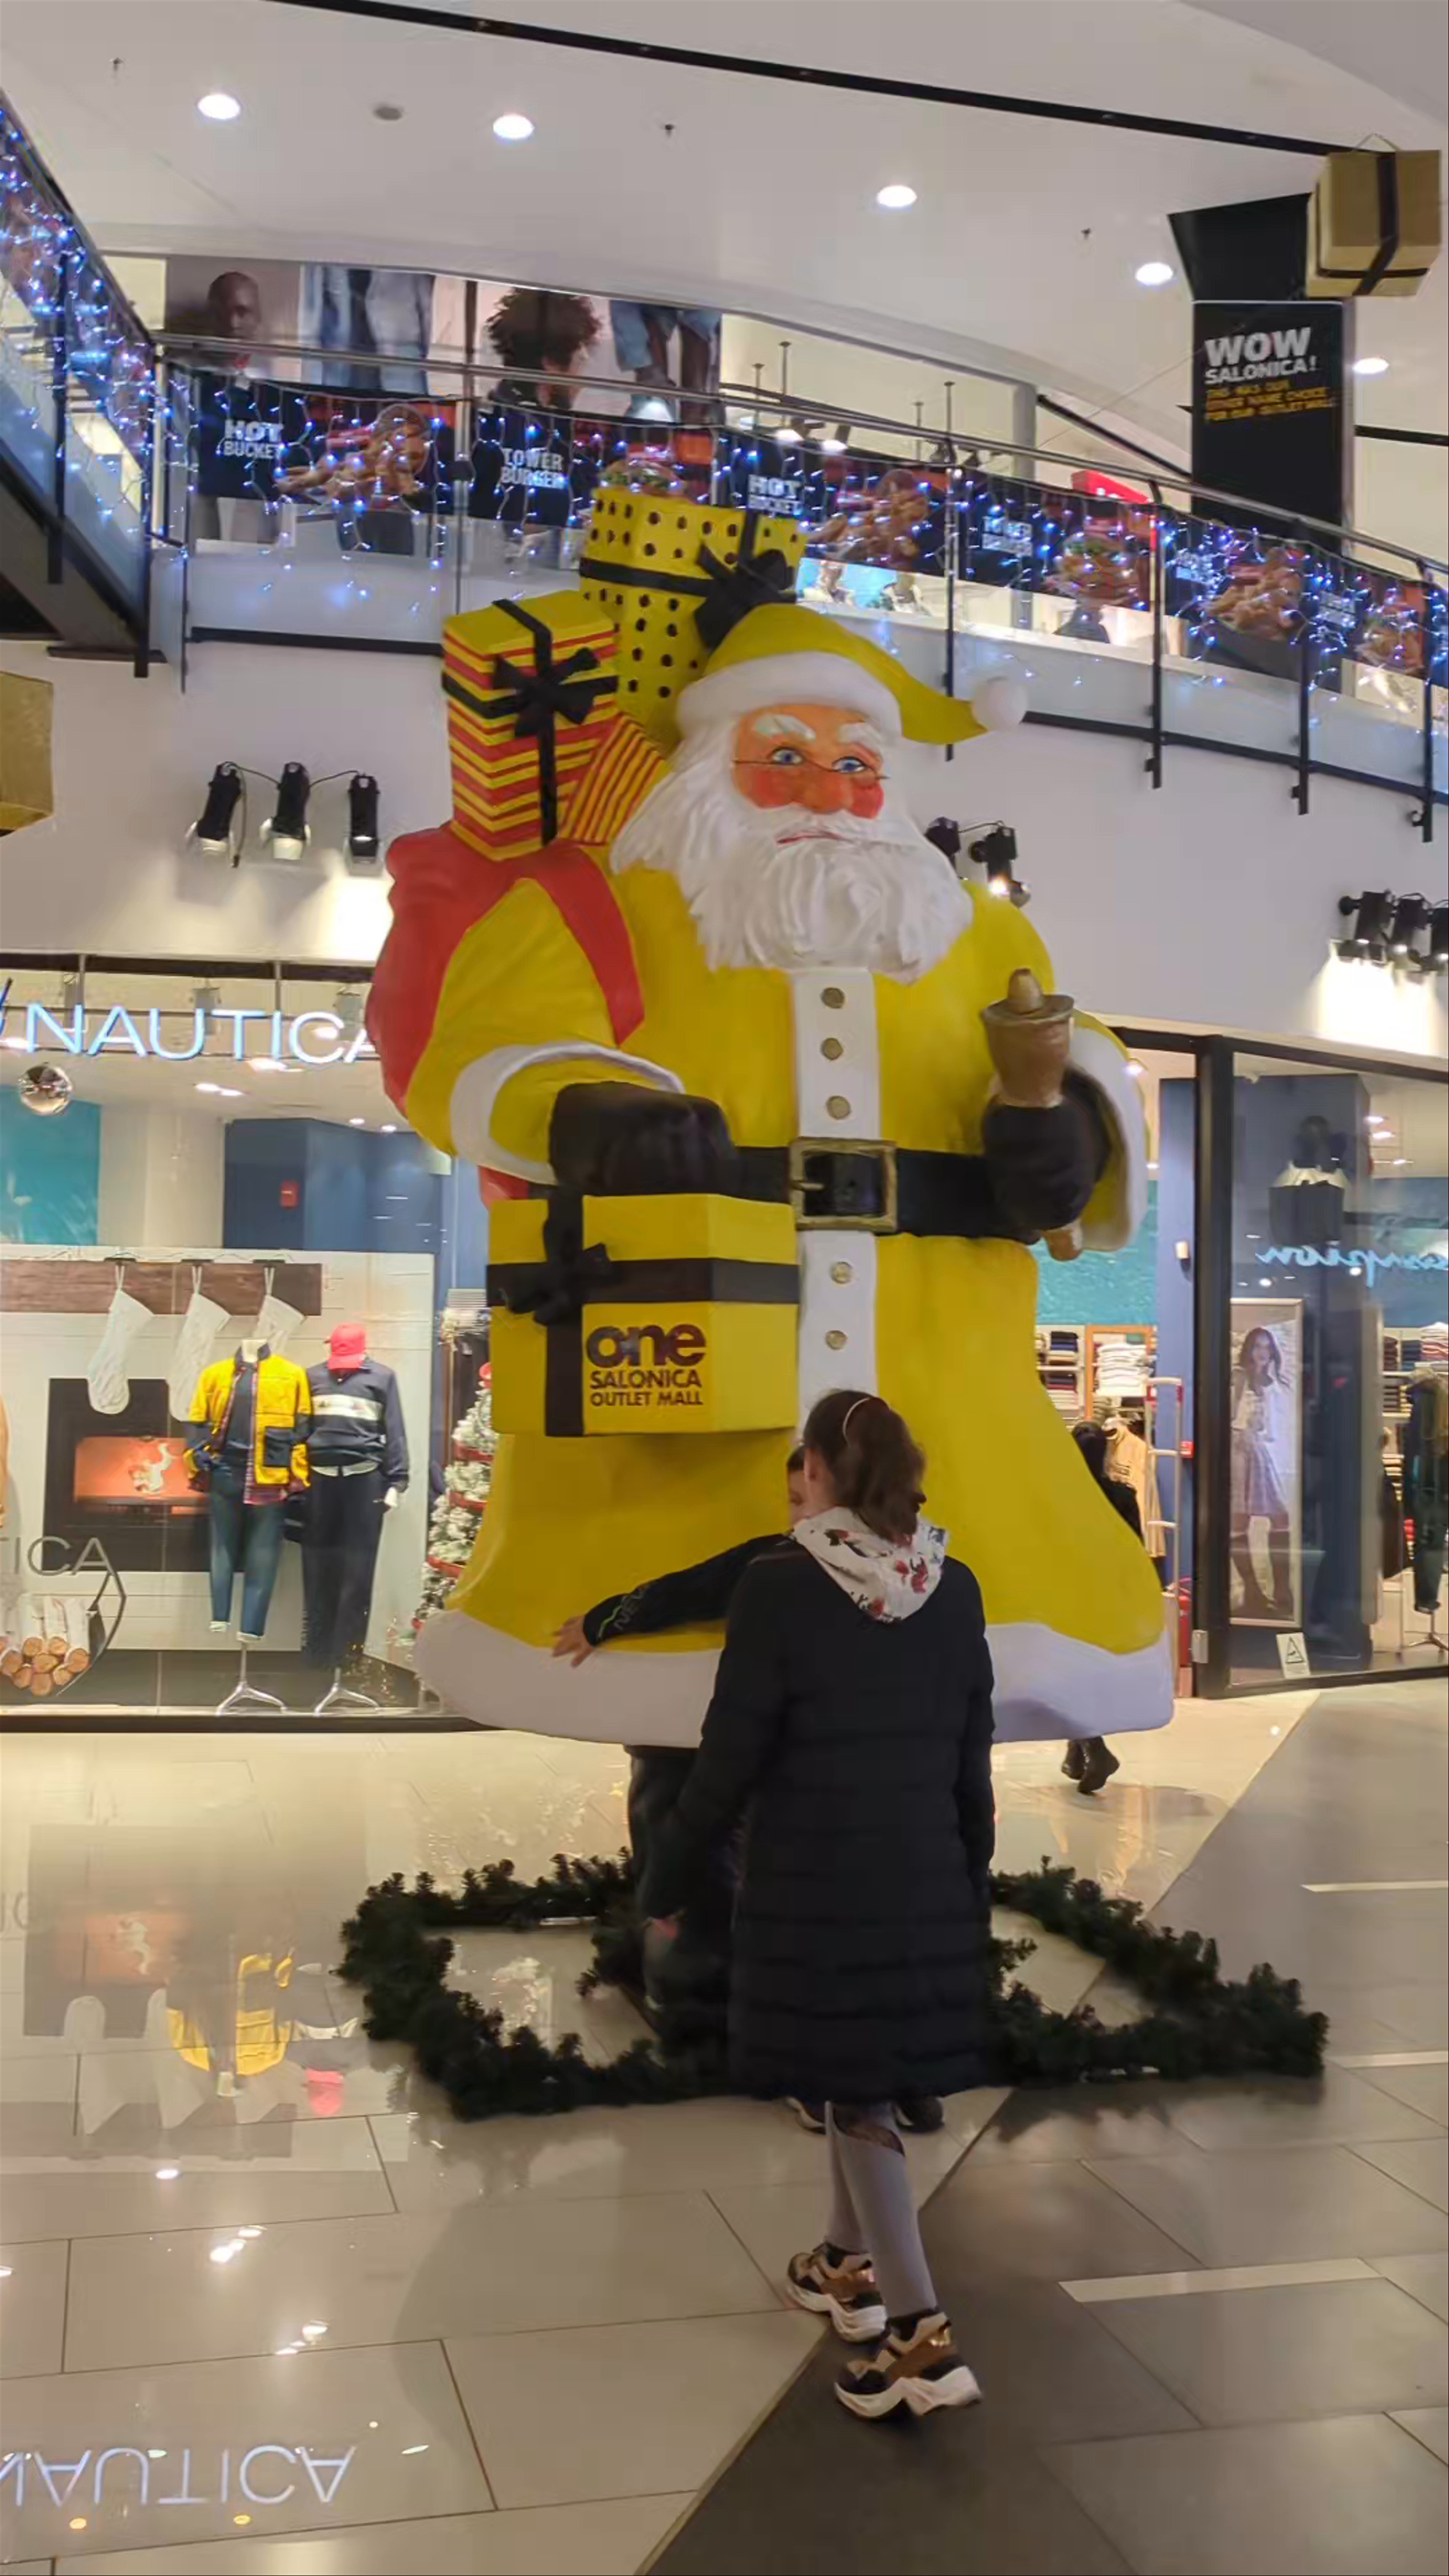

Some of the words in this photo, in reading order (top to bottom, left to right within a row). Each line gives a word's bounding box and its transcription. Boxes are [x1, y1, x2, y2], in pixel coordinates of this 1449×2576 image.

[1204, 327, 1311, 366] WOW
[1204, 356, 1317, 384] SALONICA!
[225, 419, 285, 442] HOT
[503, 448, 564, 471] TOWER
[749, 474, 801, 499] HOT
[586, 1324, 706, 1368] one
[590, 1369, 702, 1389] SALONICA
[590, 1392, 652, 1406] OUTLET
[656, 1391, 704, 1406] MALL
